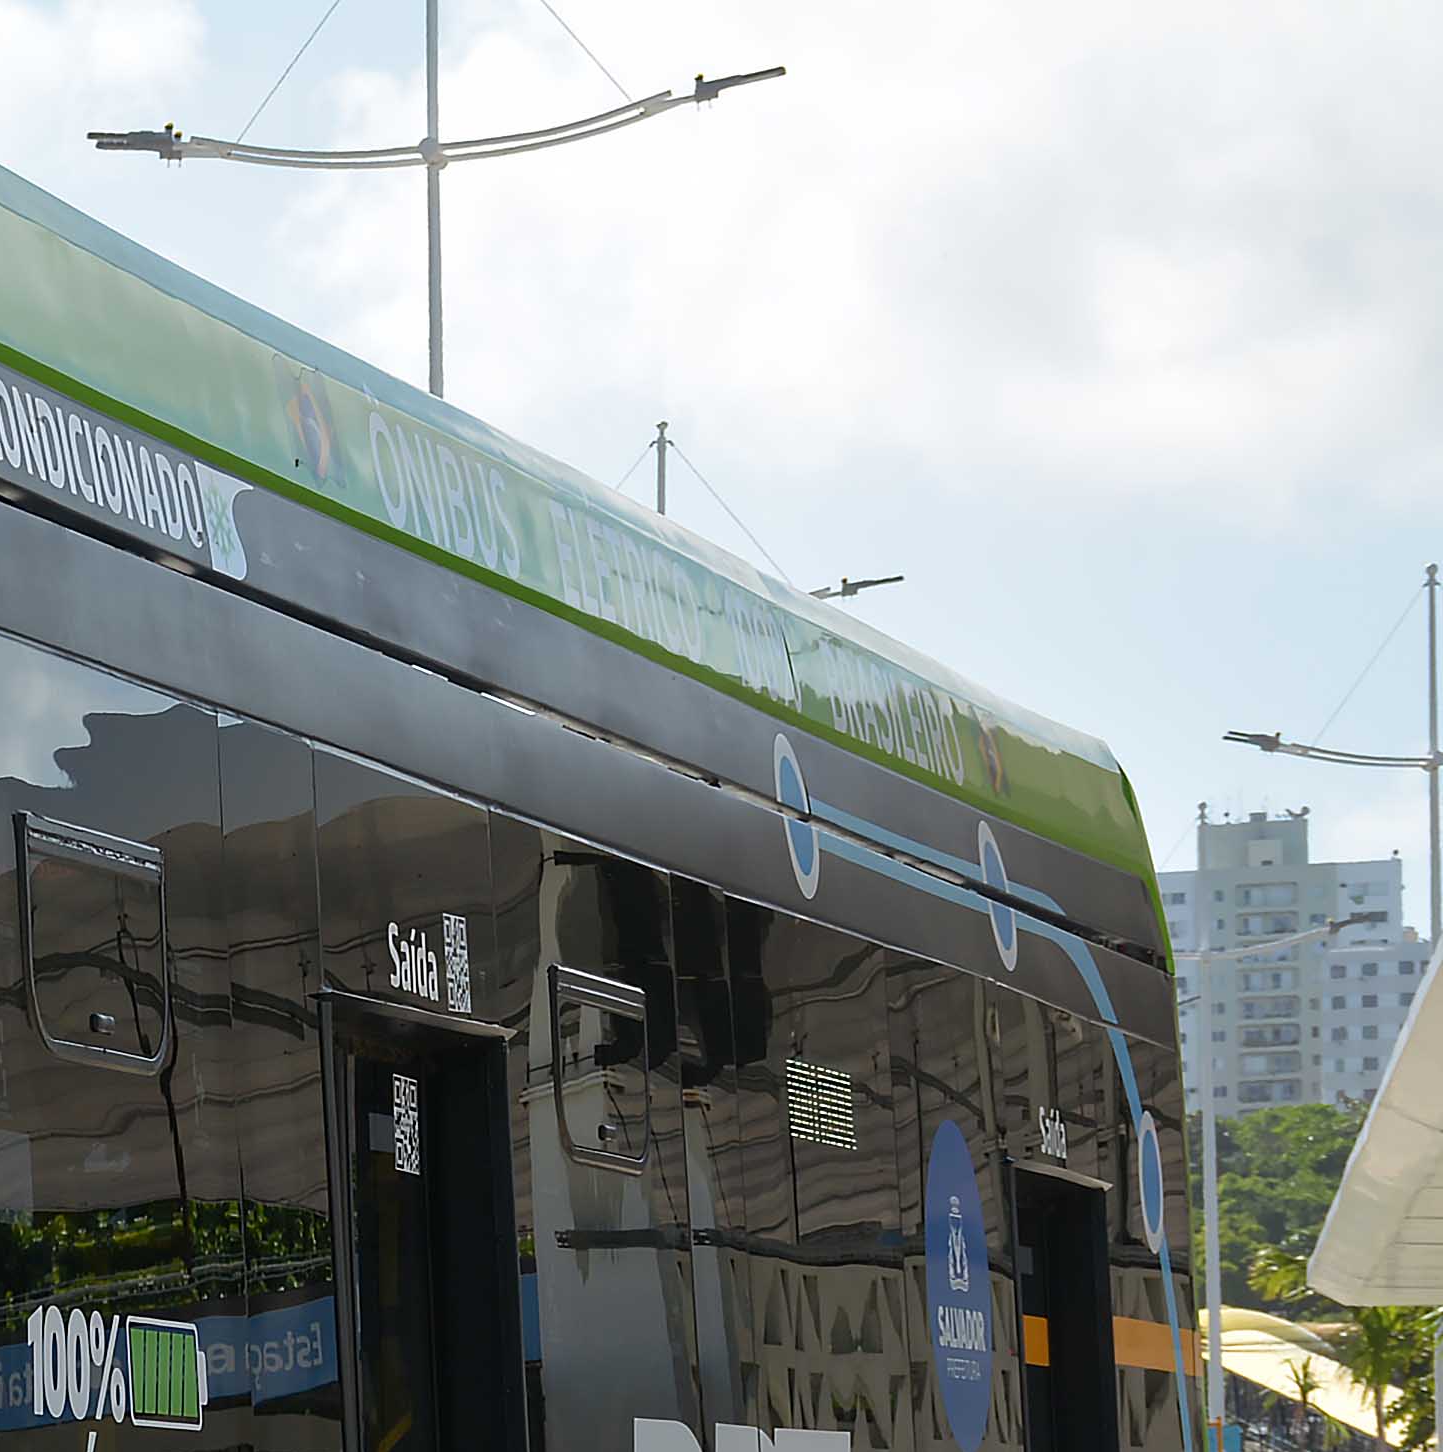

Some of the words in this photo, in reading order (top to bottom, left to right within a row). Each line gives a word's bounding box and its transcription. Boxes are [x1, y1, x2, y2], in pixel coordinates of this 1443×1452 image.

[363, 385, 521, 580] ÔNIBUS
[388, 921, 438, 1002] Saída
[1039, 1106, 1067, 1159] Saída
[27, 1305, 127, 1424] 100%
[938, 1305, 986, 1352] SALVADOR
